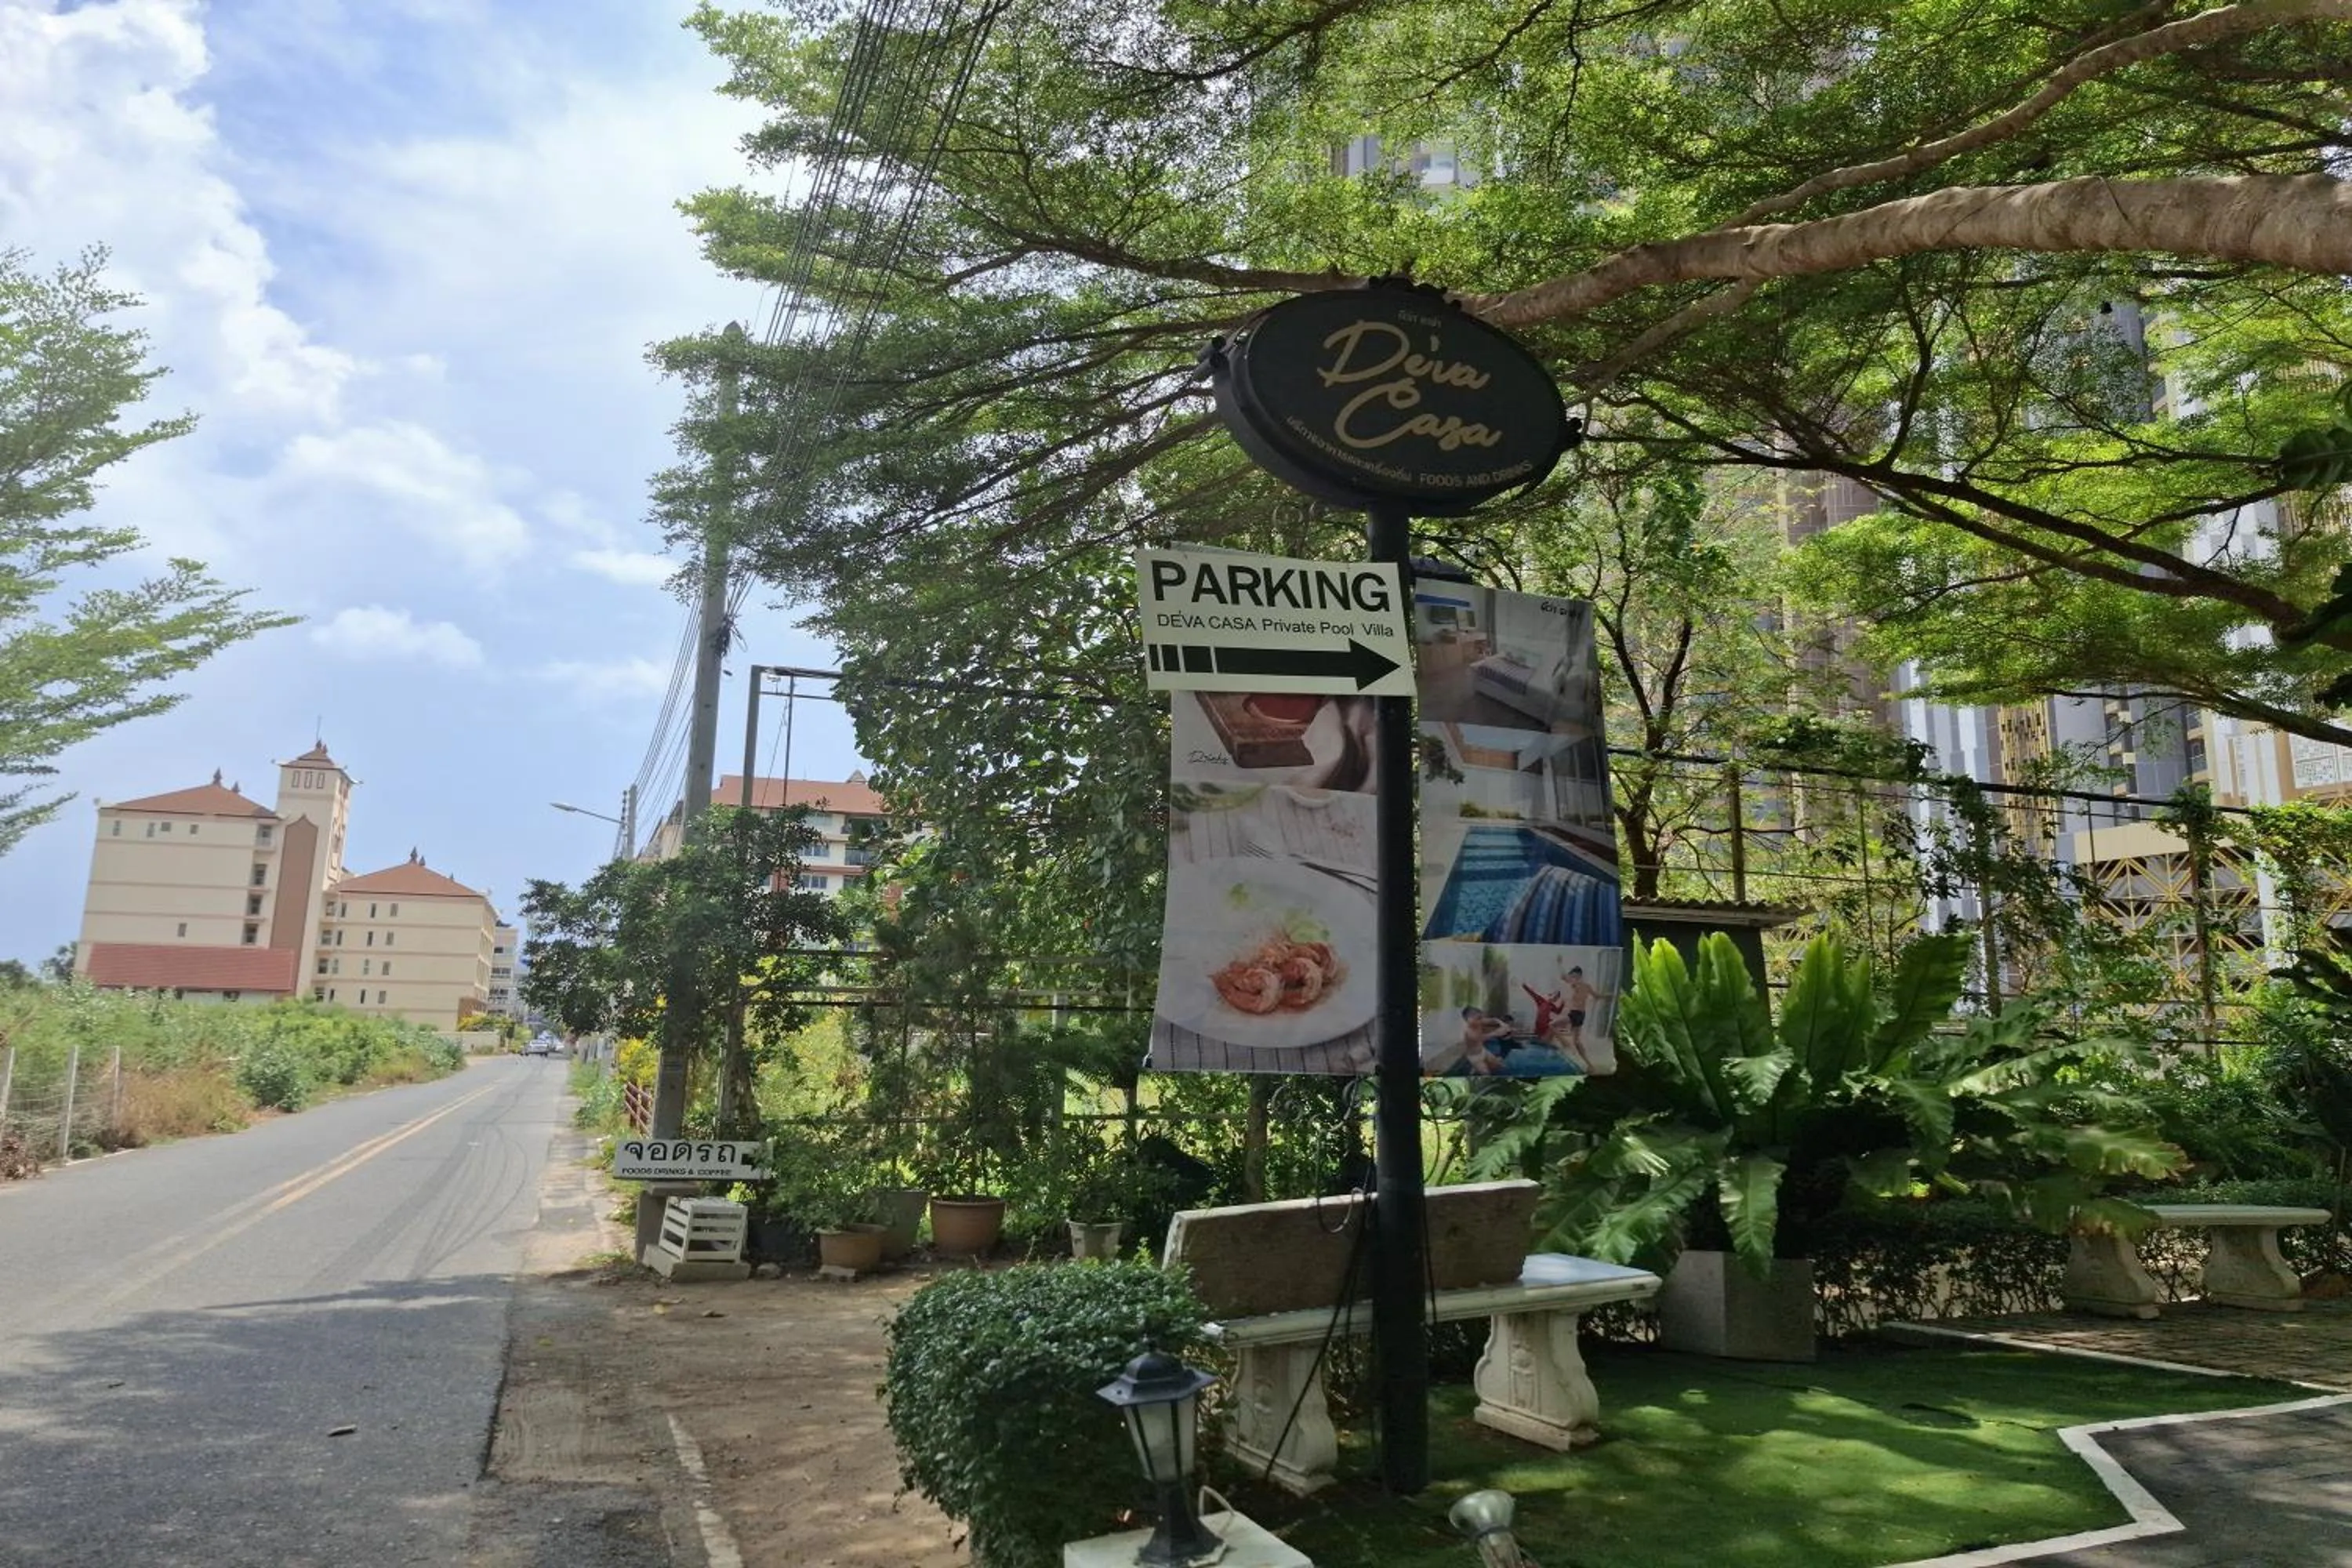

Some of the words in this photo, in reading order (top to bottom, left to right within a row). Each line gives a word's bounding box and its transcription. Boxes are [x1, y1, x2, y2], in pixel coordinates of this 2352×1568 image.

[1334, 377, 1502, 451] Casa
[1420, 473, 1463, 488] FOODS
[1466, 473, 1490, 488] AND
[1150, 560, 1391, 613] PARKING
[1208, 615, 1258, 631] CASA
[1261, 619, 1316, 634] Private
[1319, 622, 1356, 636] Pool
[1361, 622, 1395, 637] Villa
[624, 1141, 736, 1163] จอดรถ
[622, 1167, 652, 1175] FOODS
